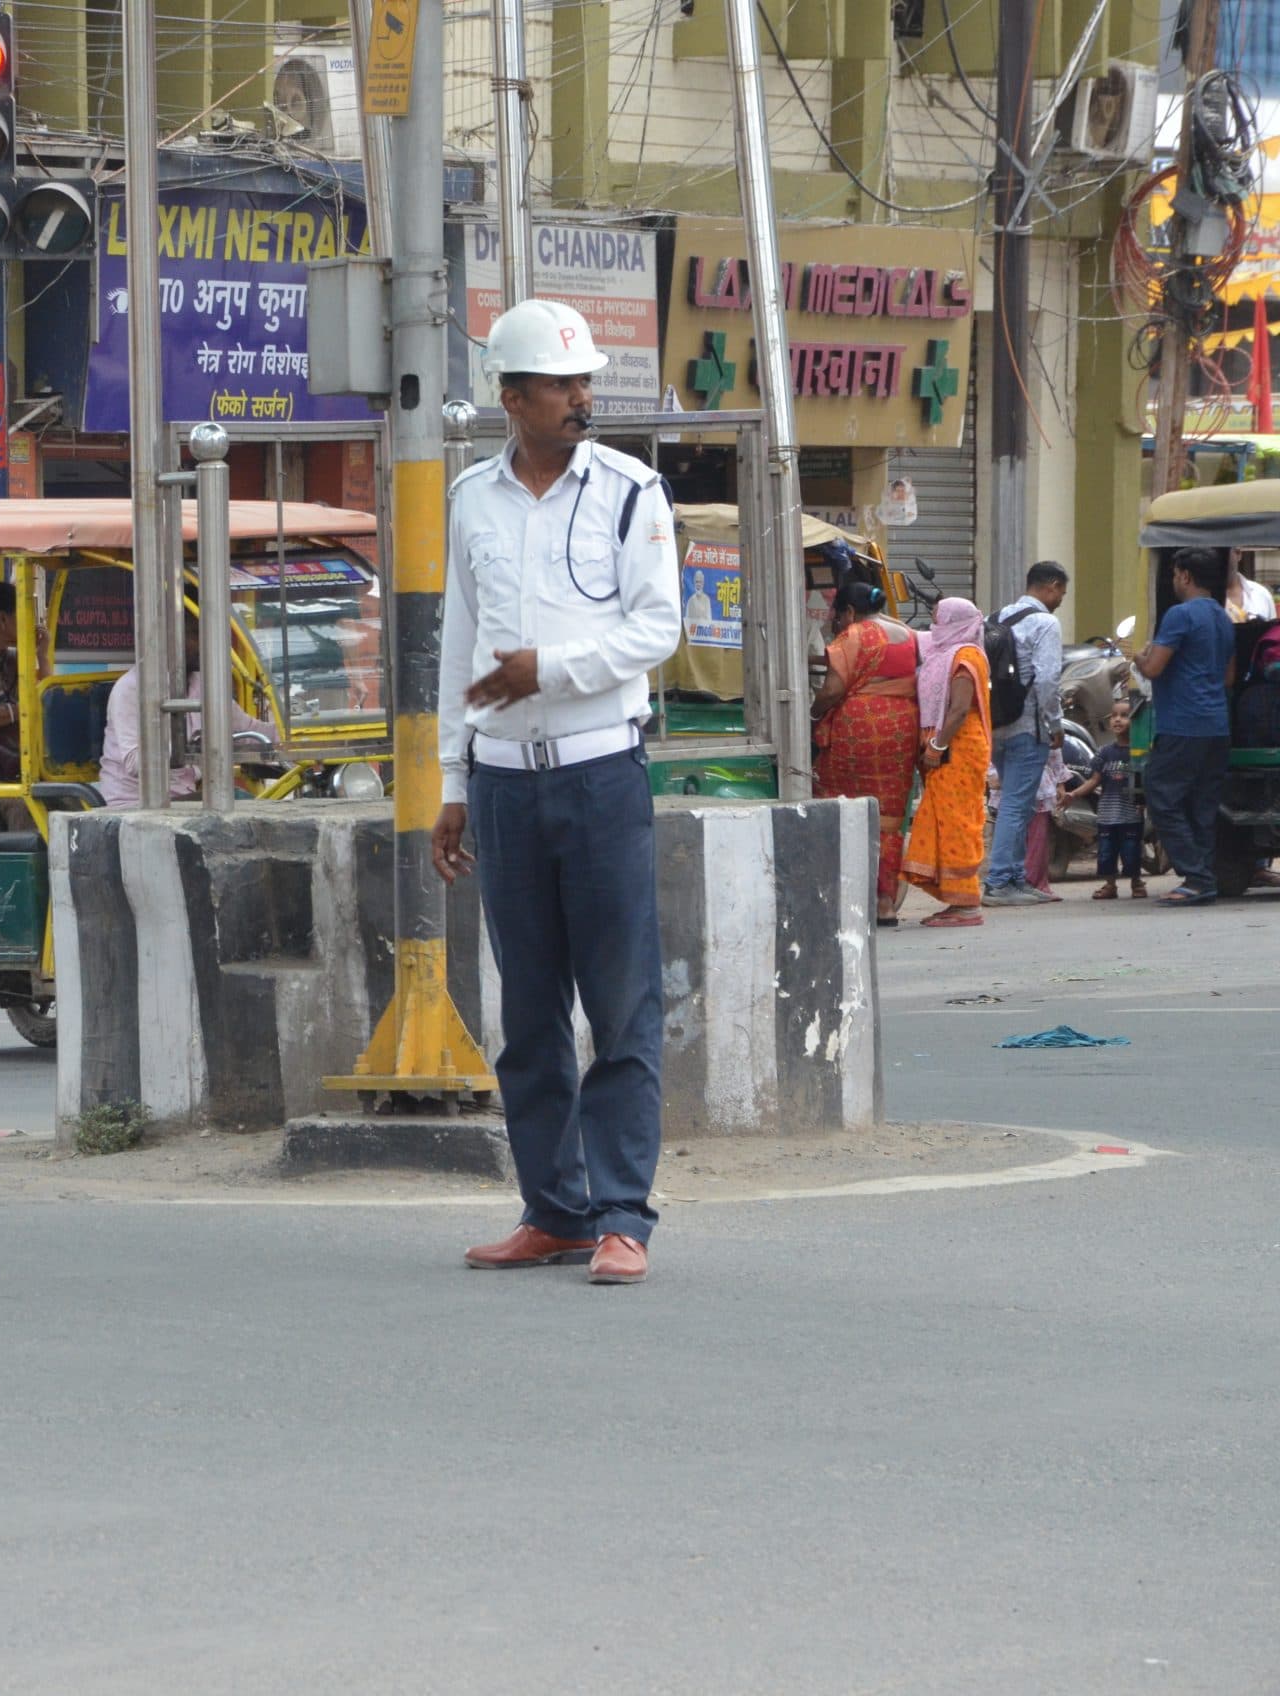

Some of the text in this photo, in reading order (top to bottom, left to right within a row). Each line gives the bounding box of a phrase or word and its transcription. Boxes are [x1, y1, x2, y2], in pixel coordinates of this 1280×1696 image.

[107, 202, 218, 260] LXMI
[538, 227, 646, 272] CHANDRA
[193, 279, 251, 330] अनुप
[603, 301, 647, 316] PHYSICIAN
[802, 262, 972, 318] MEDICALS
[197, 341, 223, 374] नेत्र
[227, 342, 257, 374] रोग
[560, 327, 576, 351] P
[68, 631, 100, 646] PHACO
